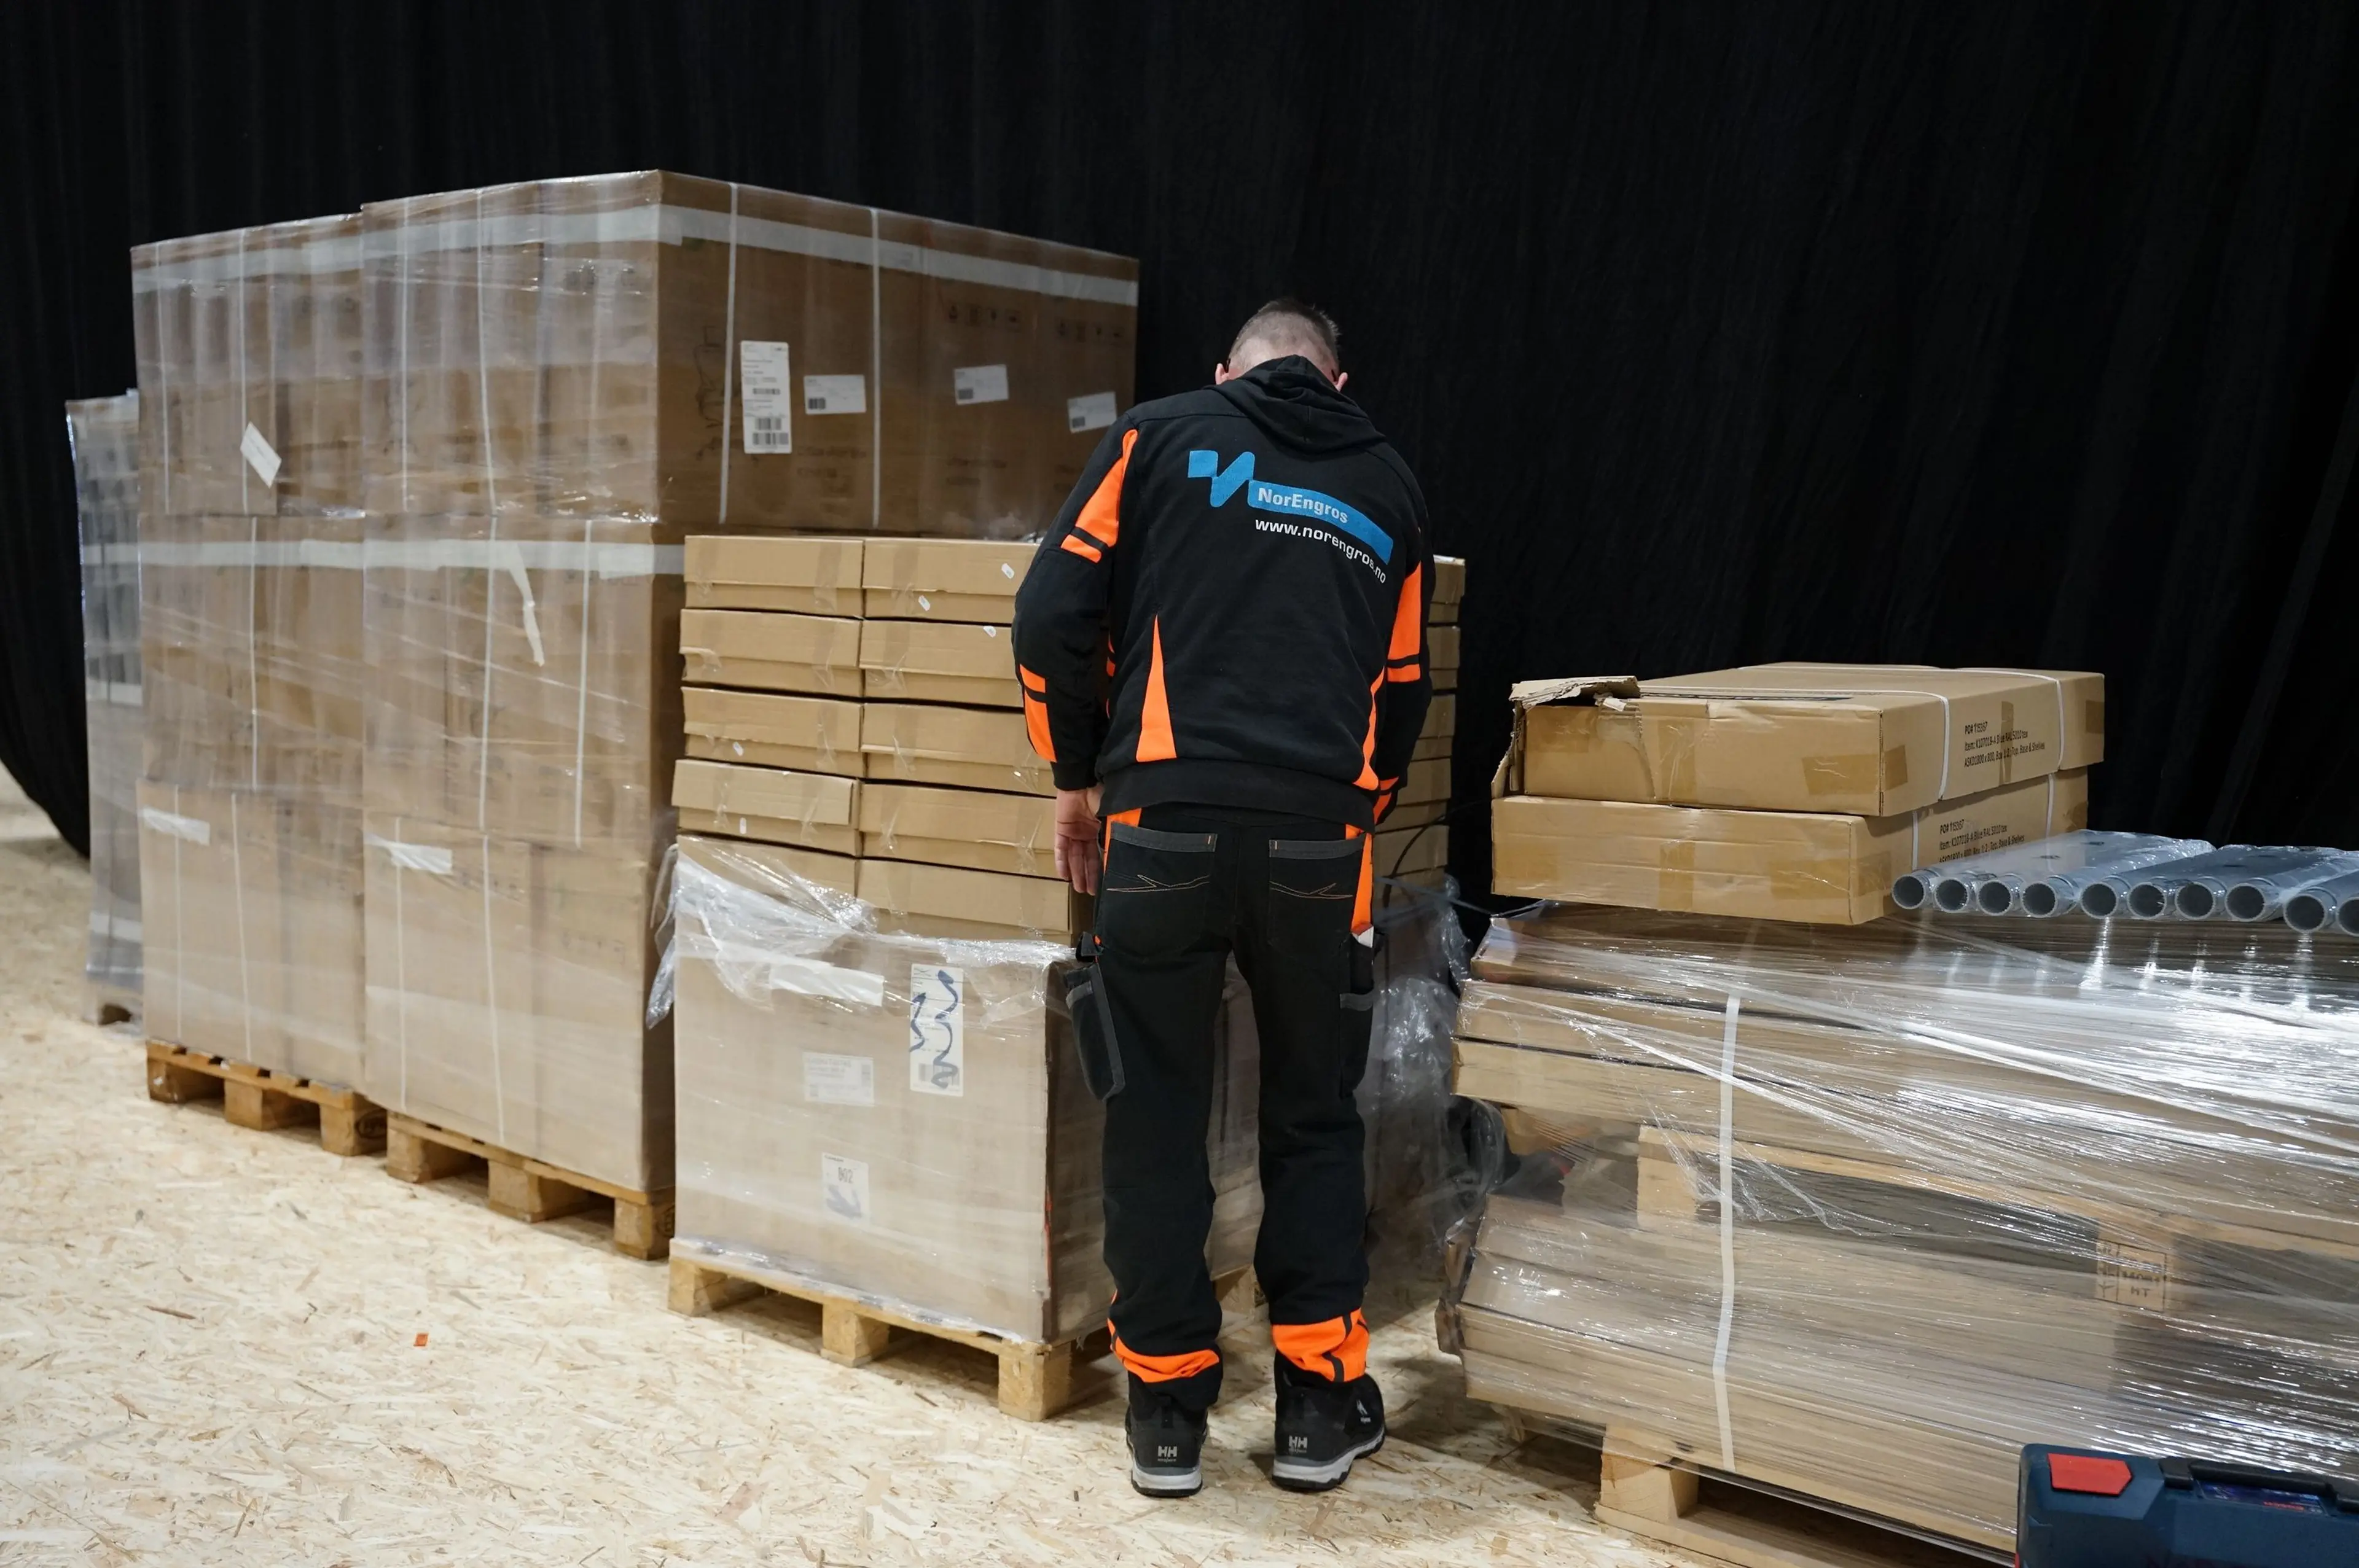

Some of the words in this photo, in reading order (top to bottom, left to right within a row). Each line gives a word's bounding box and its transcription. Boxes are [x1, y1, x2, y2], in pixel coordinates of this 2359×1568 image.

[1258, 488, 1348, 523] NorEngros
[1255, 519, 1387, 583] www.norengros.no
[2020, 744, 2028, 754] Base
[2032, 741, 2045, 751] Shelves
[1974, 831, 1983, 840] Blue
[1289, 1435, 1308, 1448] HH
[1158, 1445, 1178, 1457] HH
